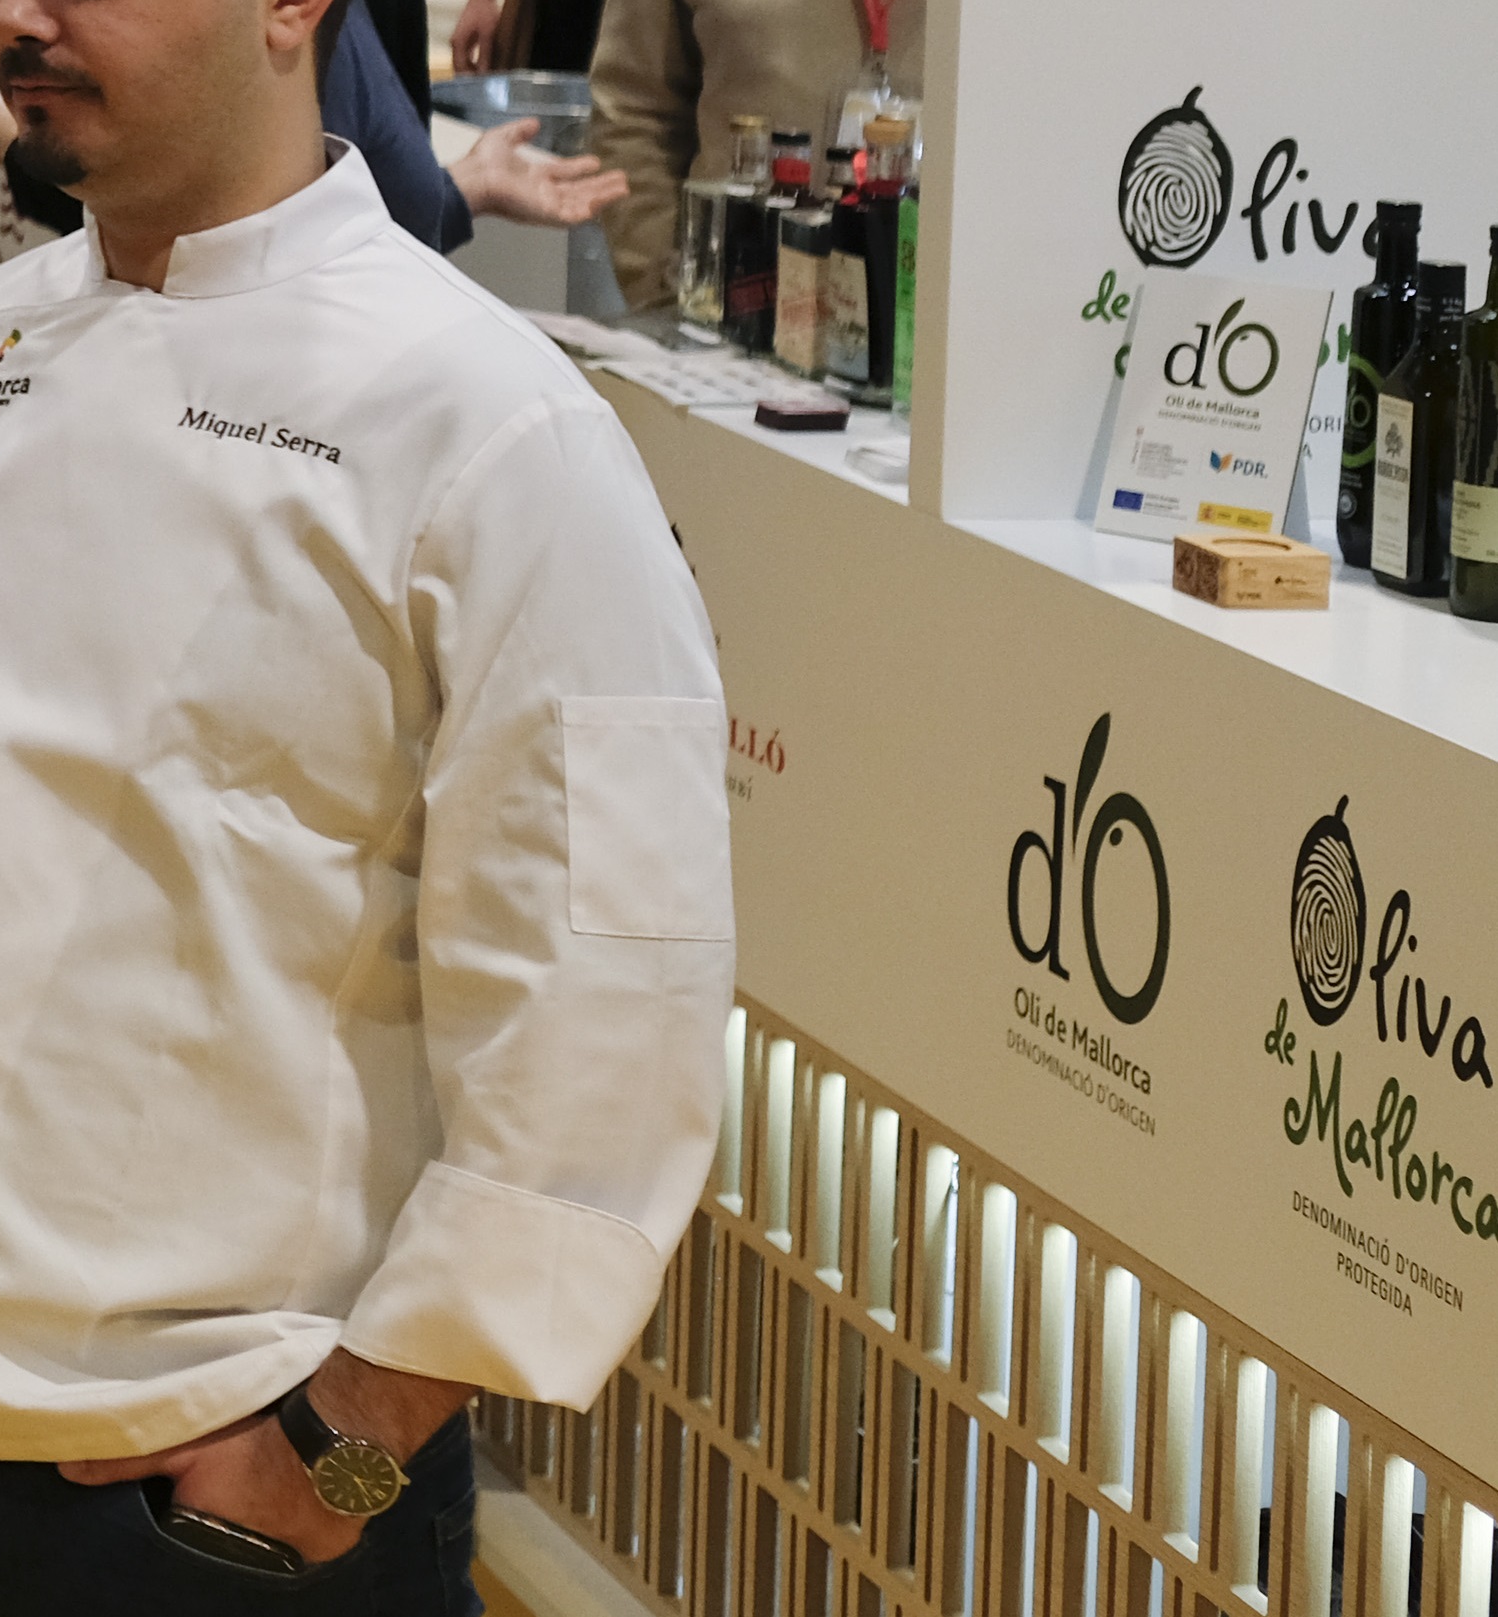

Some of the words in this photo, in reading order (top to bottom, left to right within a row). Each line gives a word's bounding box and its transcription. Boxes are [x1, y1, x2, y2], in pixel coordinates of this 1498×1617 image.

[1082, 270, 1131, 323] de
[178, 406, 267, 444] Miquel
[271, 427, 342, 465] Serra
[1206, 400, 1260, 419] Mallorca
[1290, 795, 1494, 1089] Oliva
[1014, 987, 1040, 1027] Oli
[1045, 1003, 1067, 1044] de
[1073, 1019, 1152, 1096] Mallorca
[1264, 998, 1296, 1066] de
[1007, 1028, 1094, 1103] DENOMINACIÓ
[1096, 1081, 1156, 1138] D'ORIGEN
[1292, 1190, 1391, 1267] DENOMINACIÓ
[1394, 1251, 1463, 1312] D'ORIGEN
[1336, 1251, 1413, 1317] PROTEGIDA
